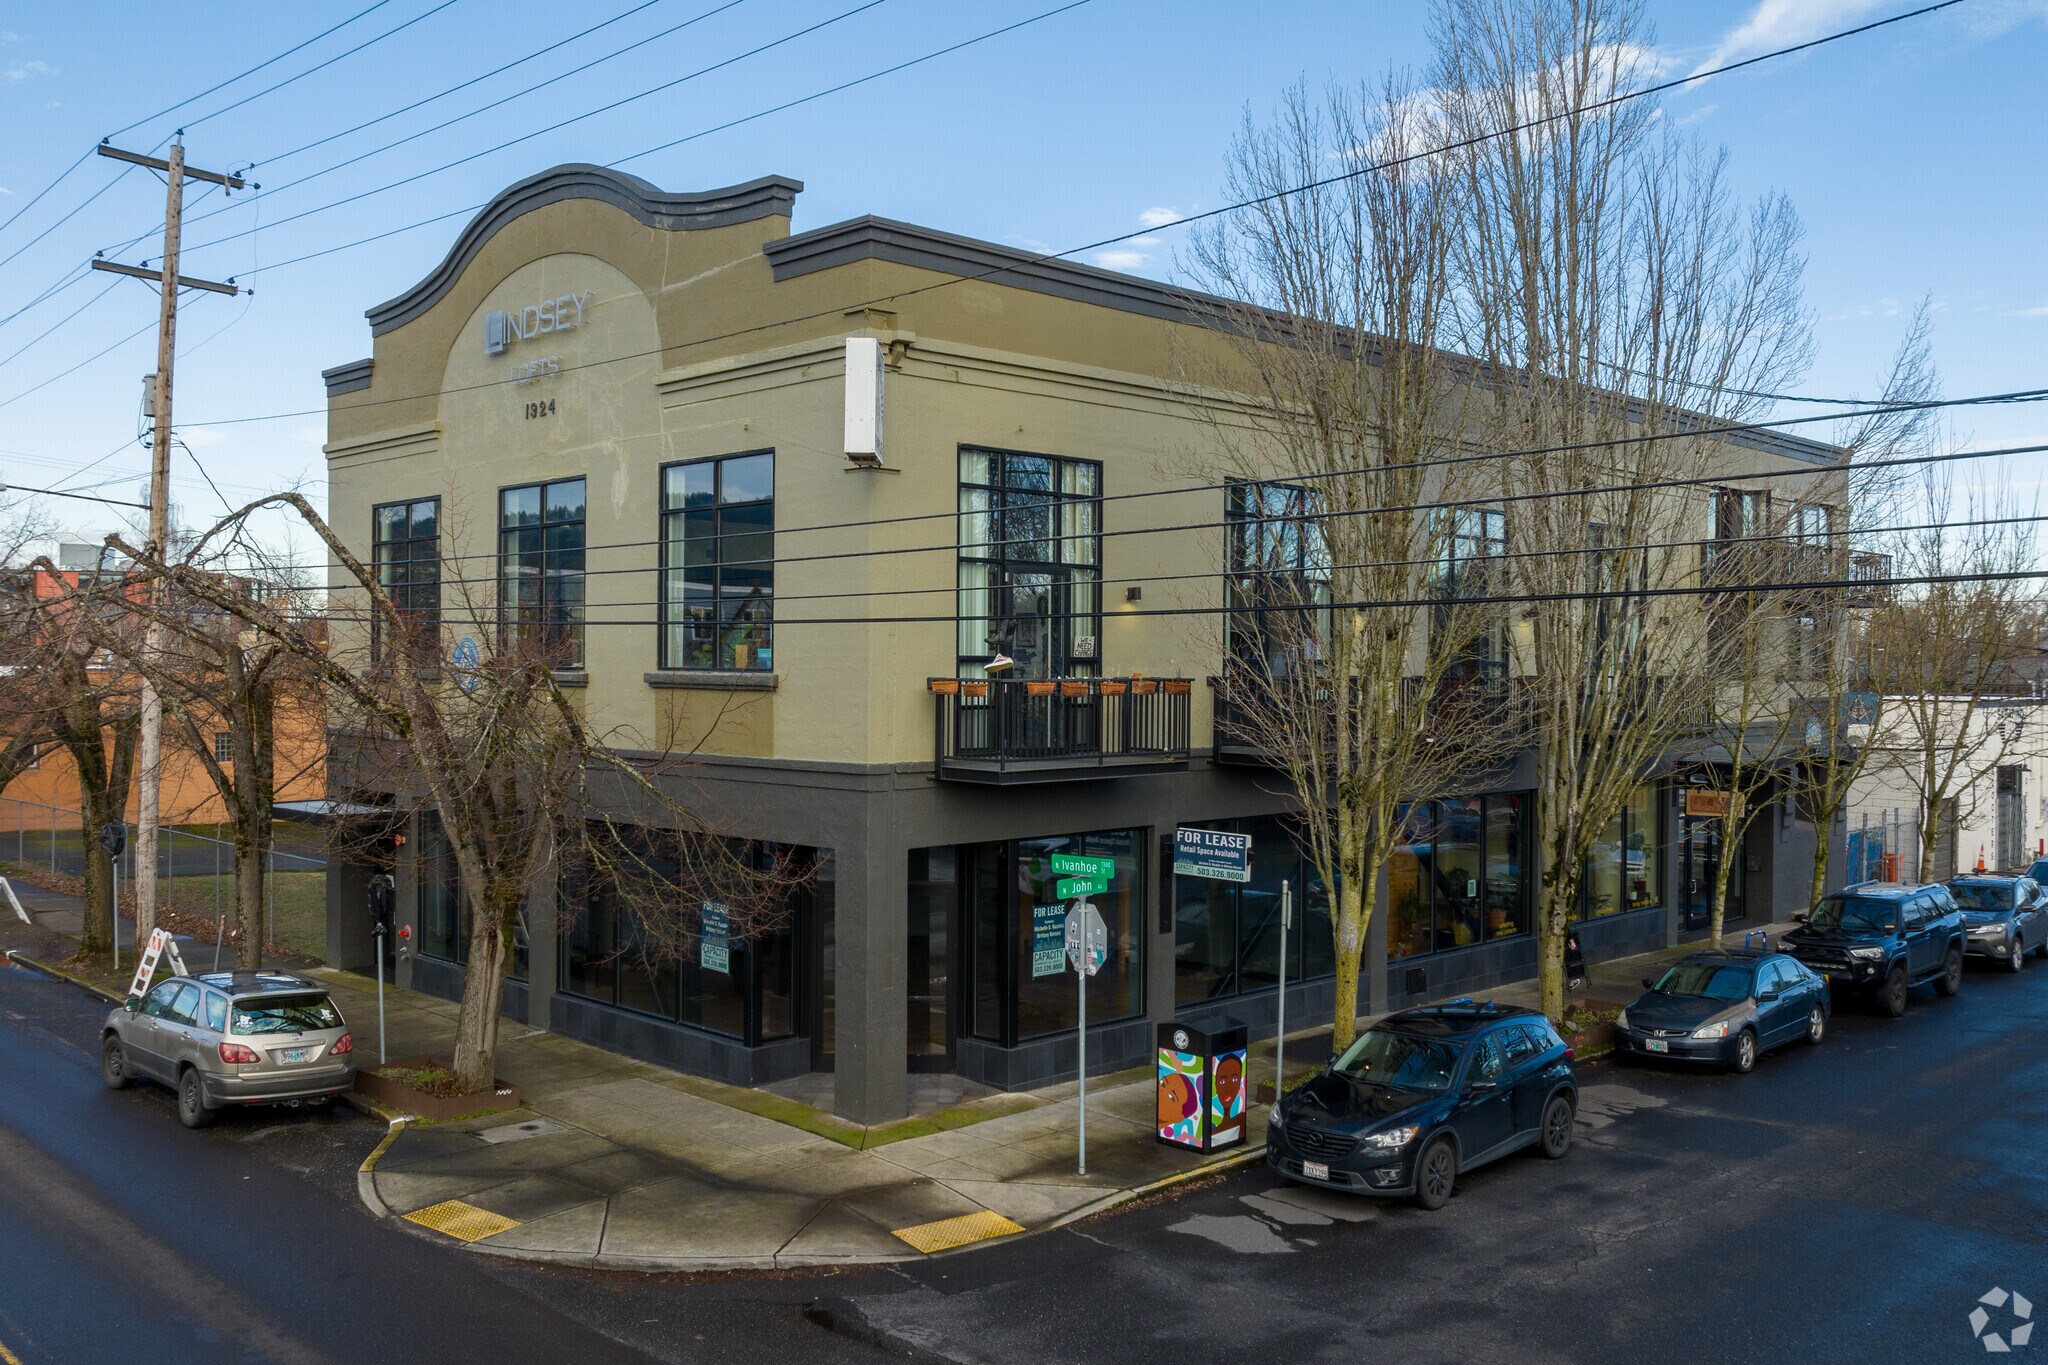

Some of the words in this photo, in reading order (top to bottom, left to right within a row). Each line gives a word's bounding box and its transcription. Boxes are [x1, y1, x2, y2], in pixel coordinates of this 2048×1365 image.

[484, 288, 588, 354] LINDSEY
[510, 355, 560, 386] LOFTS
[525, 398, 556, 420] 1924
[1176, 830, 1201, 844] FOR
[1205, 833, 1244, 849] LEASE
[1180, 844, 1196, 854] Retail
[1196, 846, 1214, 856] Space
[1214, 848, 1240, 859] Available
[1061, 859, 1097, 873] Ivanhoe
[1197, 867, 1244, 880] 503.326.9000
[1062, 887, 1067, 895] N
[1072, 880, 1092, 894] John
[1034, 907, 1046, 918] FOR
[1047, 904, 1065, 916] LEASE
[703, 945, 728, 958] CAPACITY
[1034, 949, 1064, 963] CAPACITY
